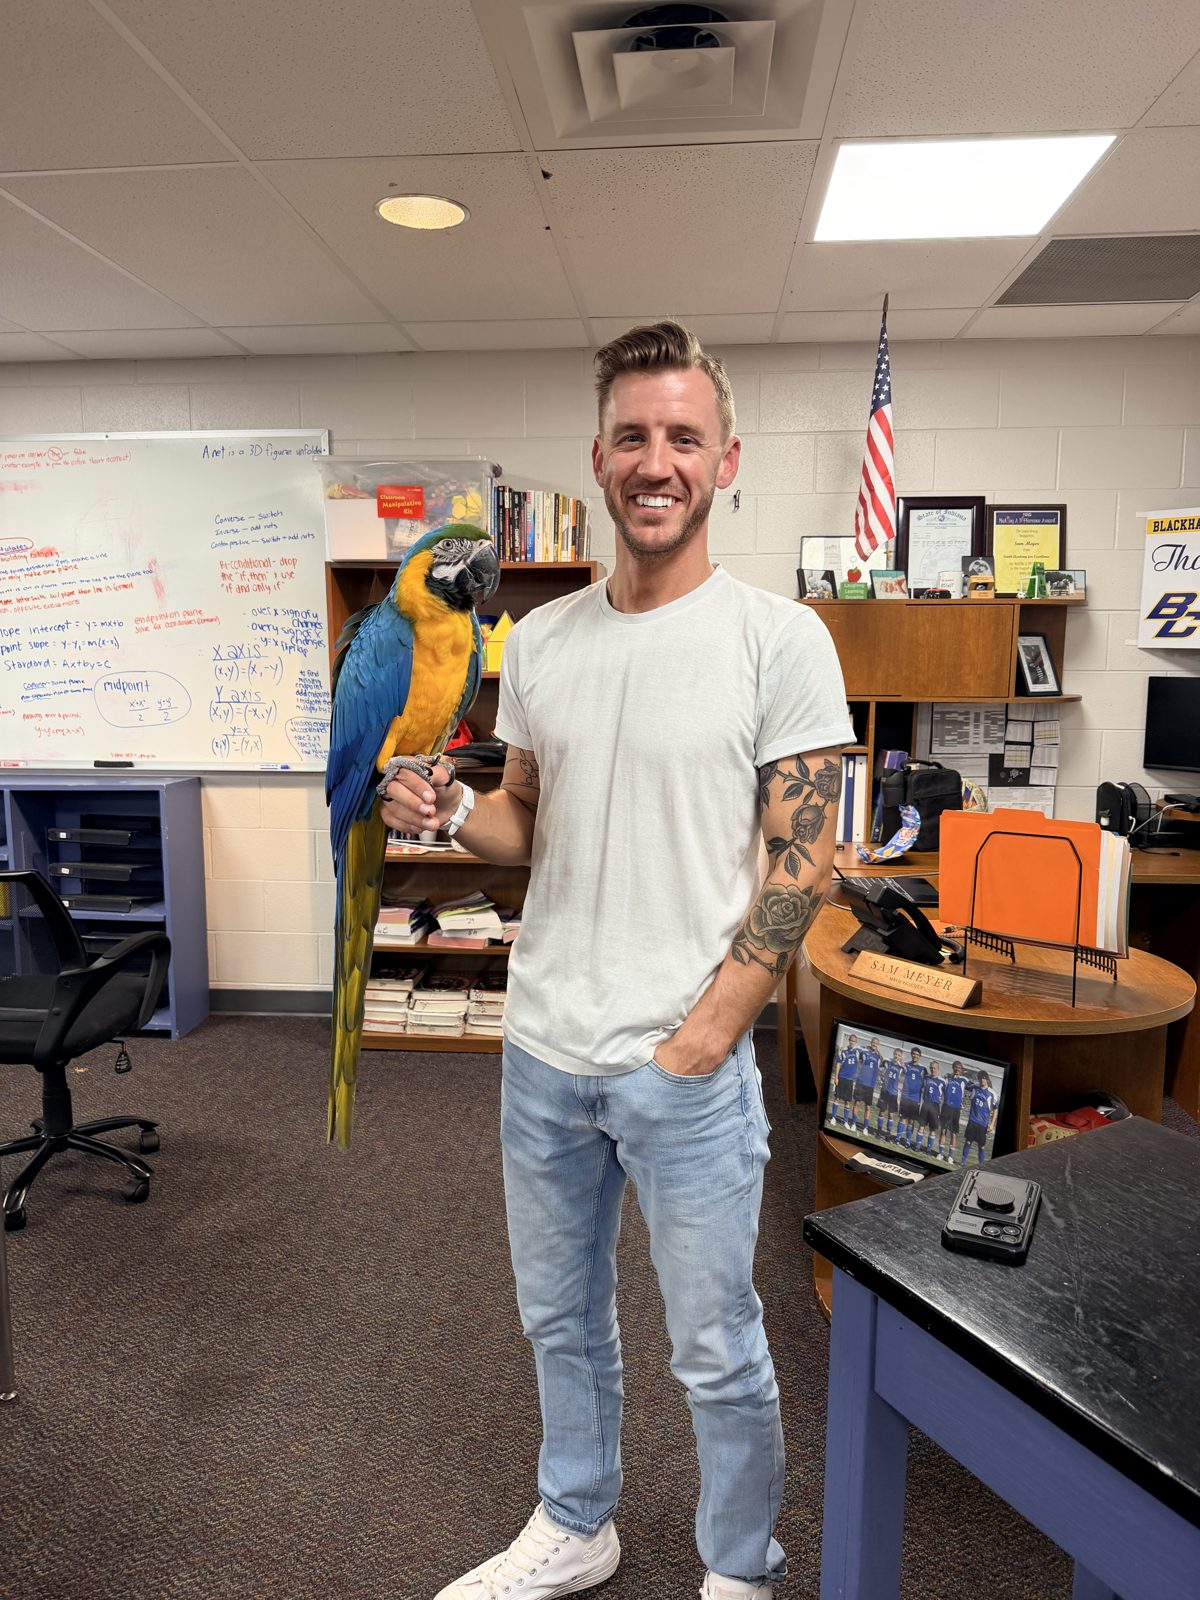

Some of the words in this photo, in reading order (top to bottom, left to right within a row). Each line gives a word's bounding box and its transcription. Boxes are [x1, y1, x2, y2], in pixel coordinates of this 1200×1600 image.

[202, 445, 210, 458] A
[212, 445, 225, 459] net
[250, 444, 262, 456] 3D
[266, 444, 292, 460] figure
[382, 500, 422, 508] Manipulative
[214, 514, 246, 524] Converse
[280, 557, 298, 569] drop
[0, 641, 22, 655] point
[227, 643, 262, 659] axis
[104, 678, 151, 695] midpoint
[230, 689, 262, 702] axis
[870, 960, 899, 975] SAM
[903, 970, 953, 990] MEYER
[876, 1162, 911, 1176] CAPTAIN
